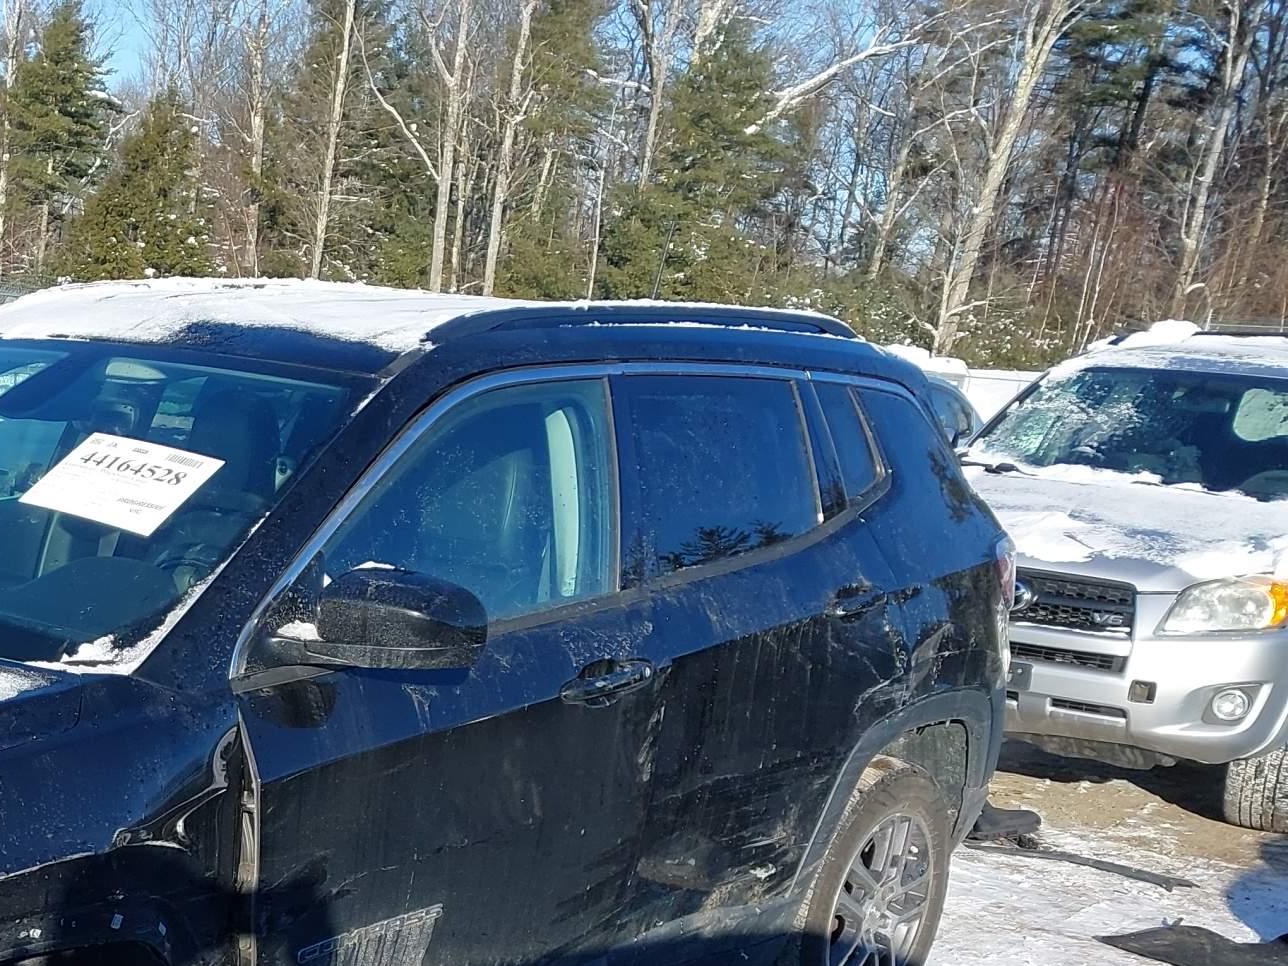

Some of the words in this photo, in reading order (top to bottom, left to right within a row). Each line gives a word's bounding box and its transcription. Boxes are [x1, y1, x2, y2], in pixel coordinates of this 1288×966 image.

[80, 451, 187, 486] 44164528
[1093, 612, 1124, 625] V6
[297, 903, 443, 964] COMPASS
